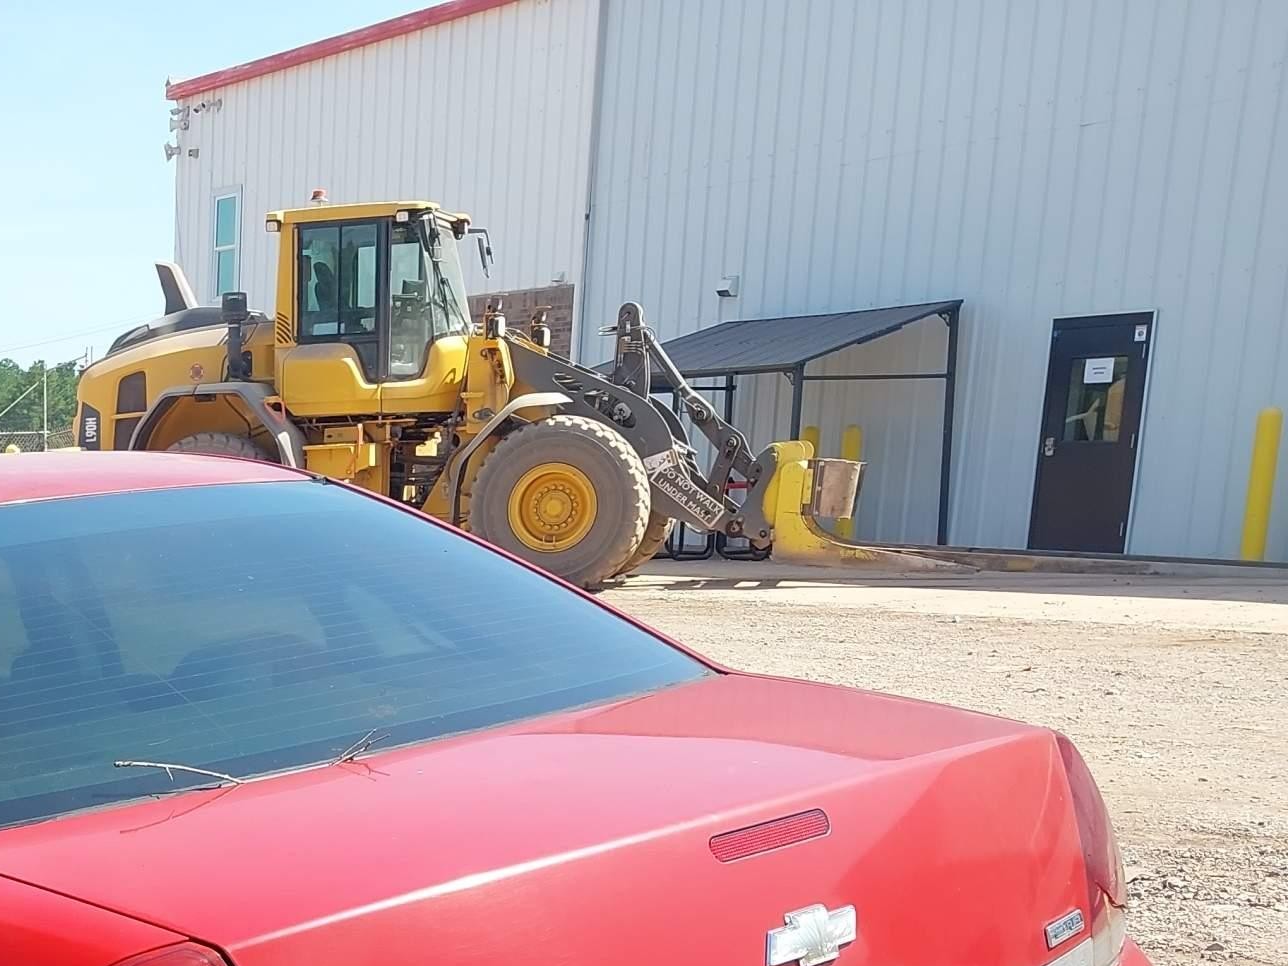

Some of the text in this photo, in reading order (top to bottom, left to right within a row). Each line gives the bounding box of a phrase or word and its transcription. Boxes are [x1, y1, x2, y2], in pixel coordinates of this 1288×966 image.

[85, 417, 97, 442] L90H
[658, 478, 688, 504] UNDER
[675, 473, 695, 494] NOT
[695, 491, 721, 514] WALK
